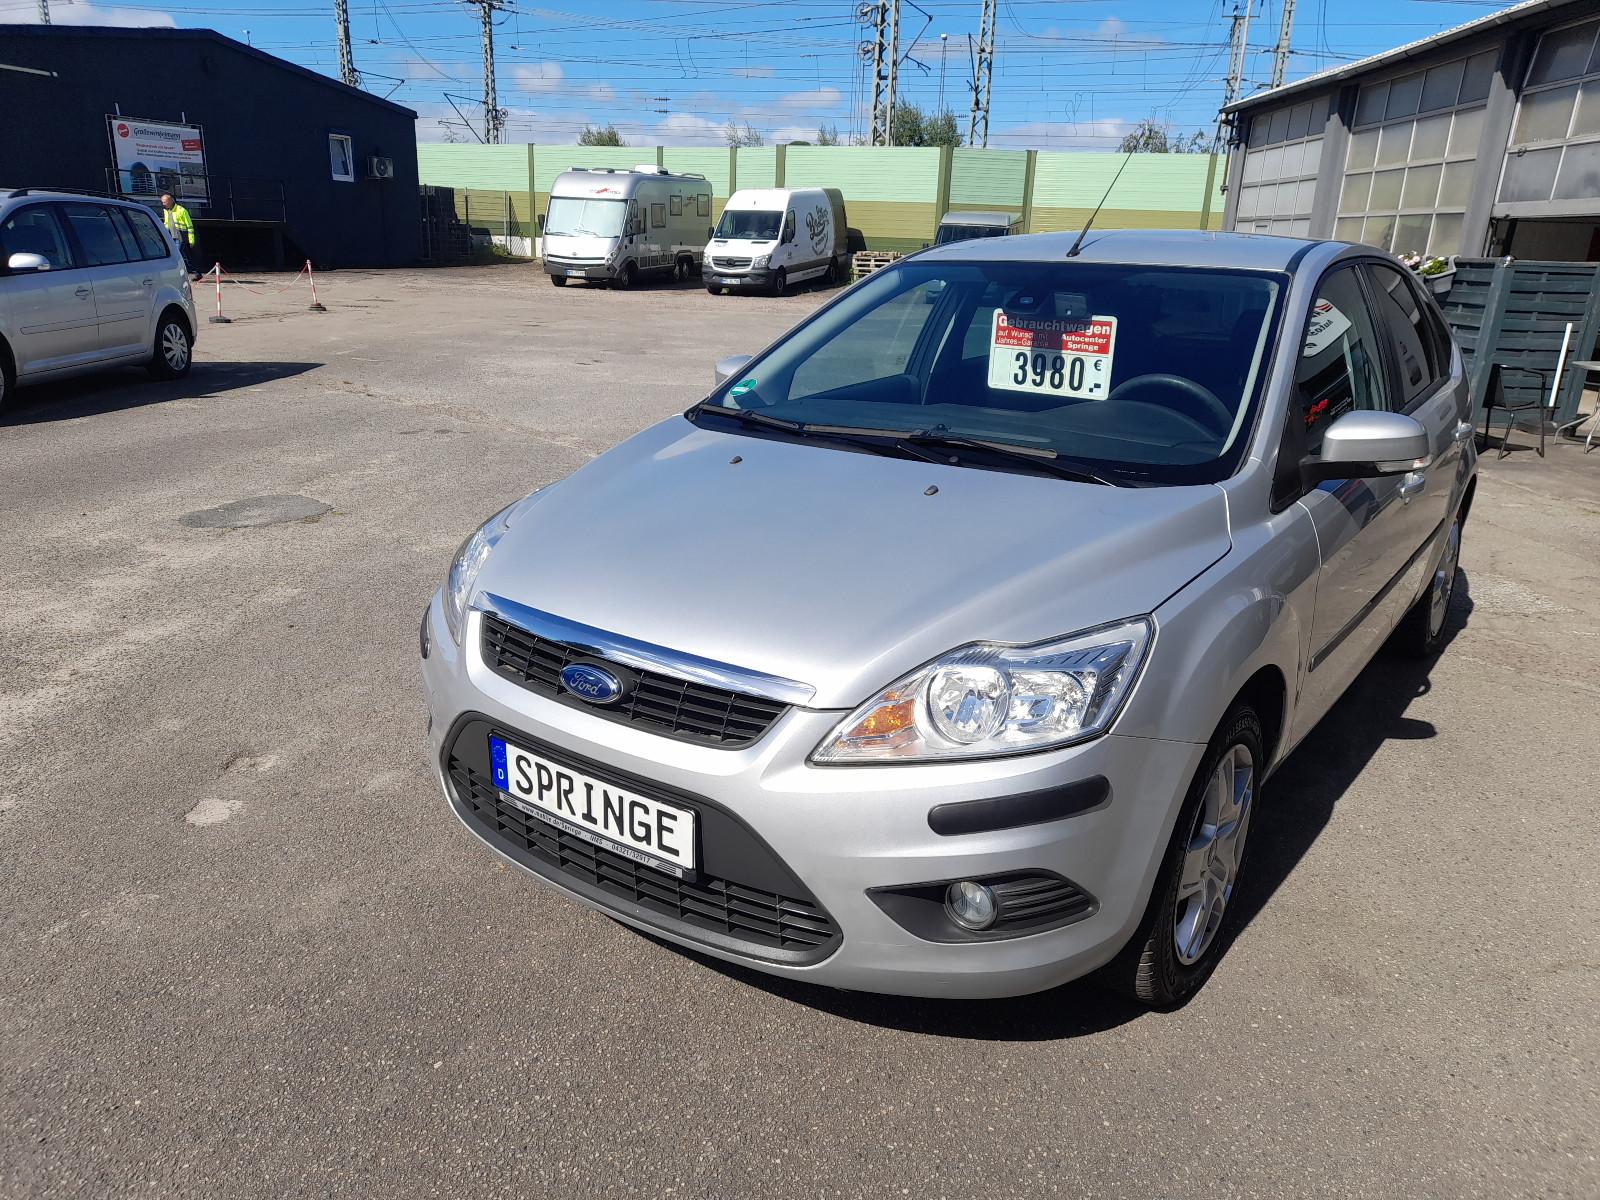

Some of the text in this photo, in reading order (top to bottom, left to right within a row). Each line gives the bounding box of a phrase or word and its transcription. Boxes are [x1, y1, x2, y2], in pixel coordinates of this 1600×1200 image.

[998, 315, 1110, 335] Gebrauchtwagen
[1062, 333, 1107, 344] Autocenter
[1067, 342, 1099, 351] Springe
[1013, 351, 1085, 391] 3980
[1094, 359, 1103, 371] €
[570, 671, 602, 695] Ford
[497, 768, 505, 780] D
[515, 754, 680, 857] SPRINGE
